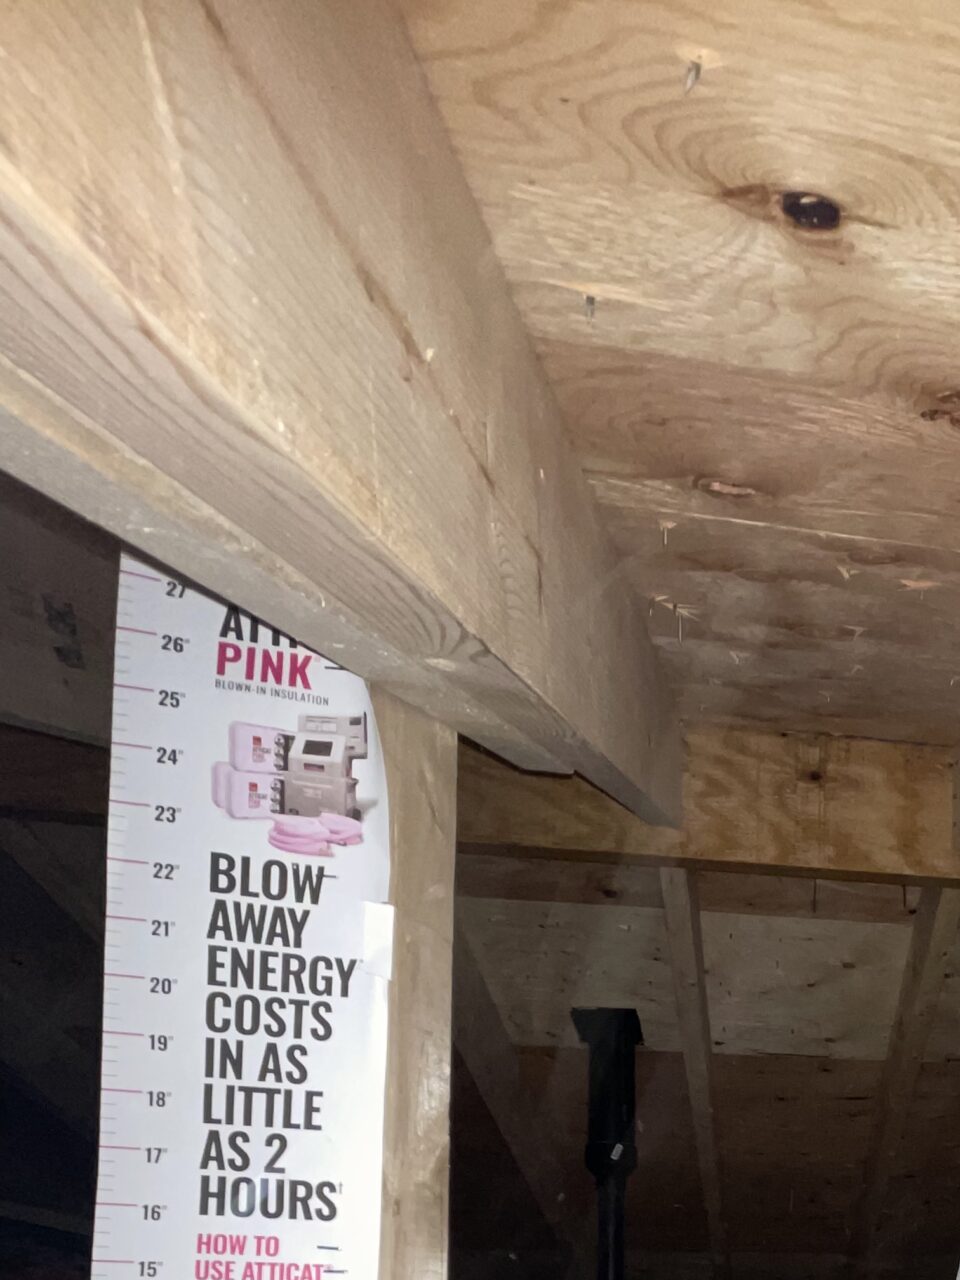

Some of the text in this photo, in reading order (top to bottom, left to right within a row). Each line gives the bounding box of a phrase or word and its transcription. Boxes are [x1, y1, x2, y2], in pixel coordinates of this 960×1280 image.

[215, 679, 329, 706] BLOWN-IN INSULATION
[209, 852, 325, 905] BLOW
[206, 899, 310, 948] AWAY
[205, 991, 333, 1041] COSTS
[204, 1037, 308, 1084] IN AS
[202, 1083, 323, 1131] LITTLE
[199, 1130, 288, 1174] AS 2
[196, 1233, 280, 1257] HOW TO
[194, 1260, 236, 1280] USE
